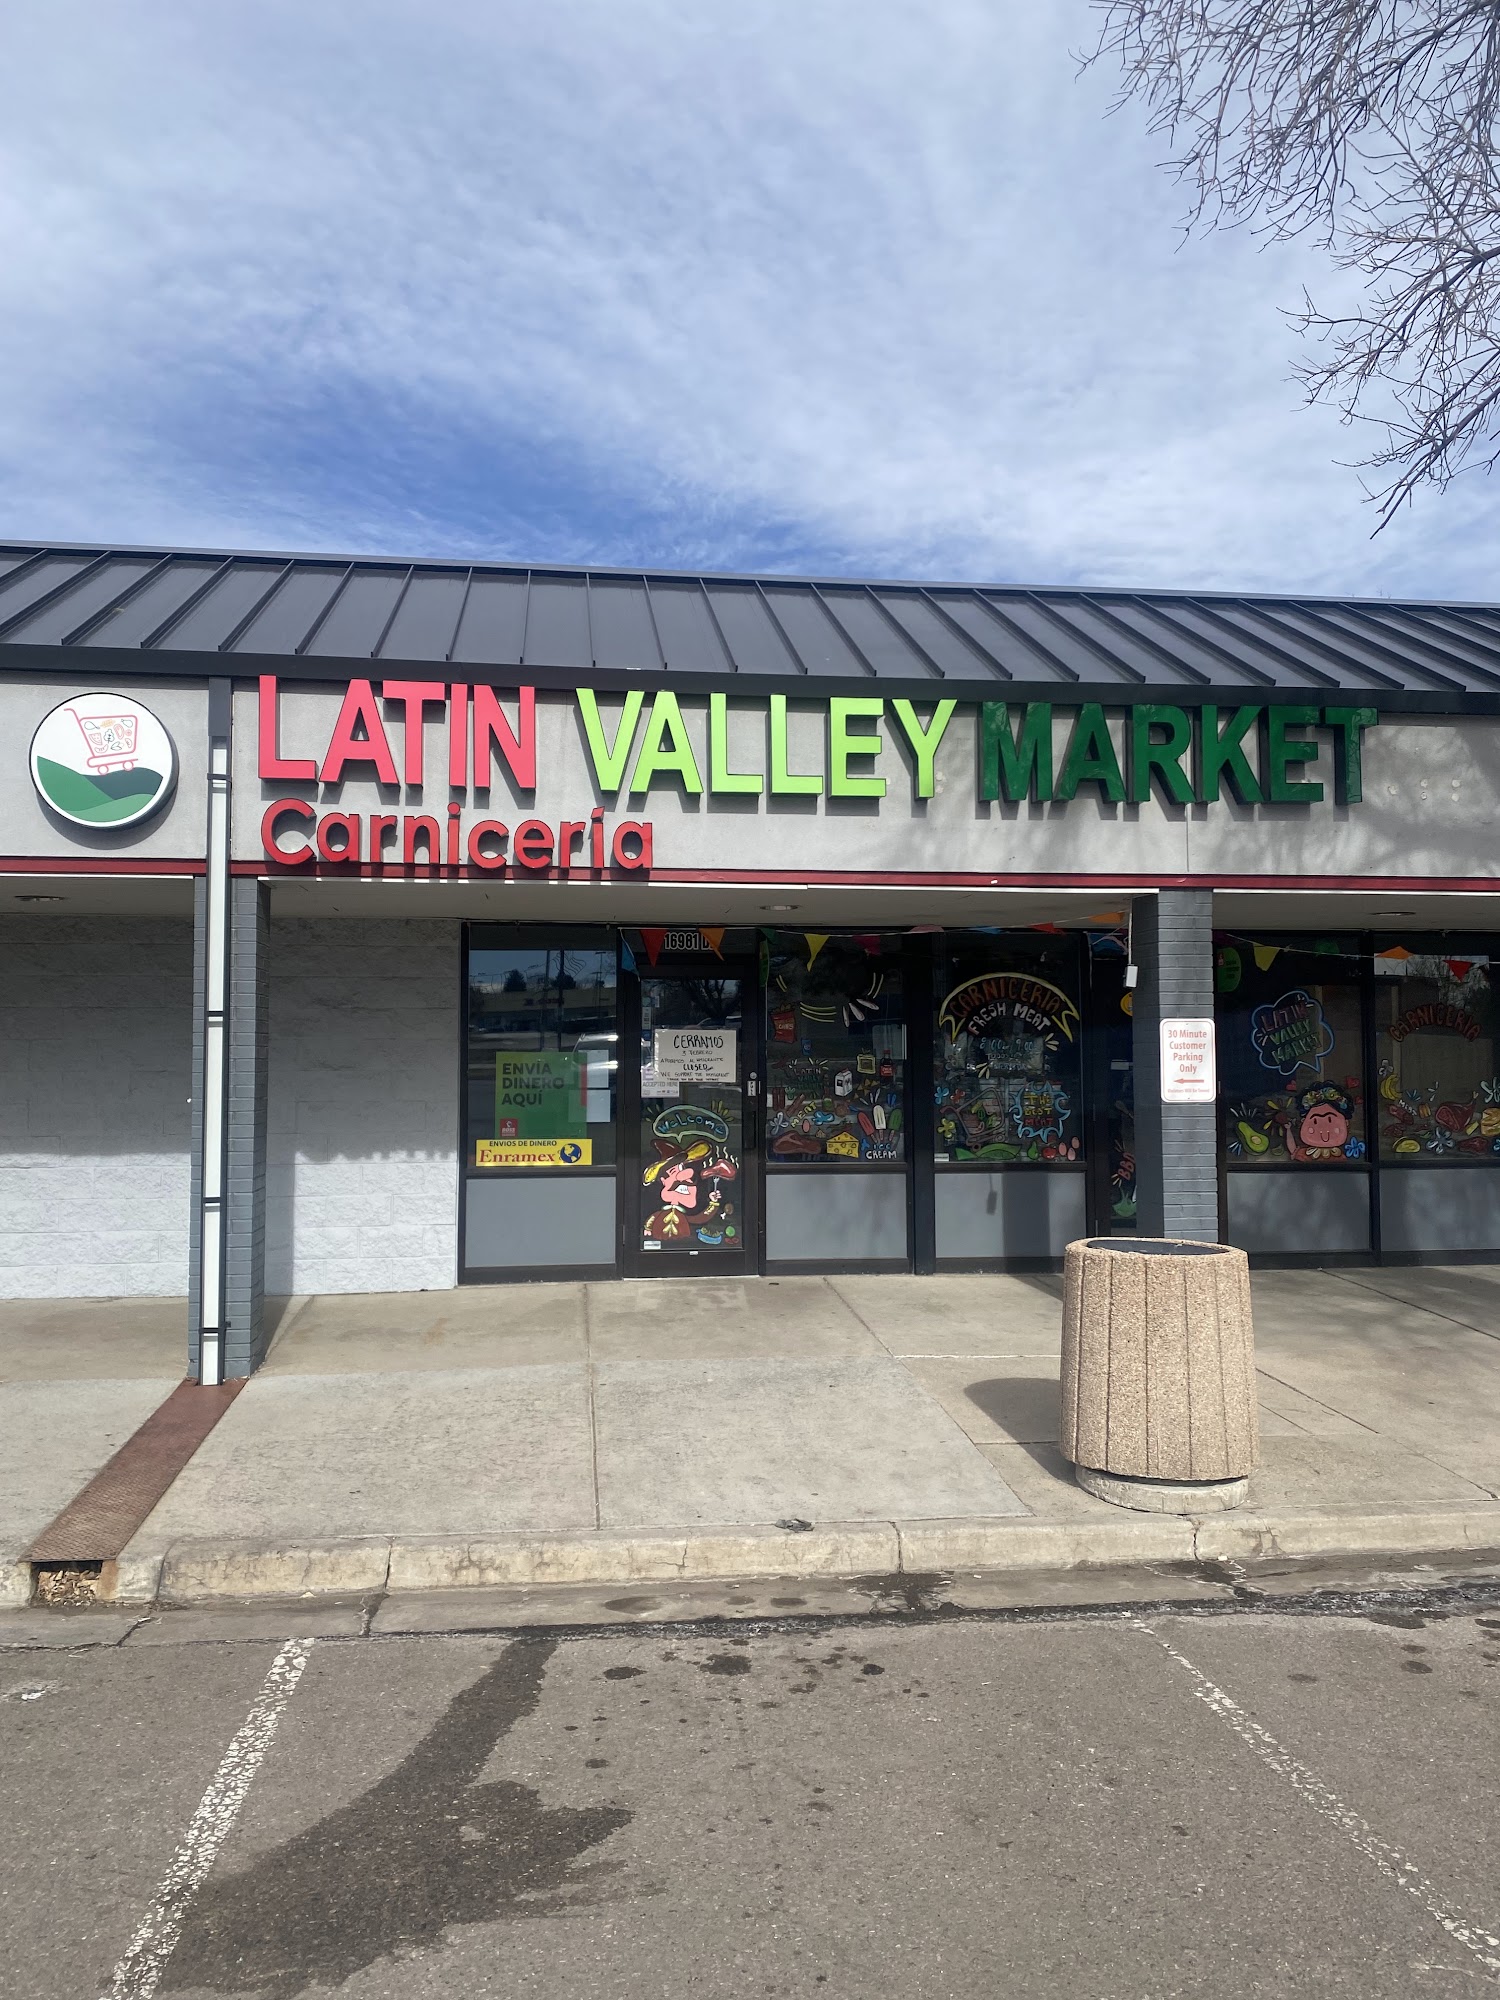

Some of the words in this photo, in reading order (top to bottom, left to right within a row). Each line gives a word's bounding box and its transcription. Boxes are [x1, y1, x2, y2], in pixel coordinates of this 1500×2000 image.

[258, 675, 537, 790] LATIN
[575, 687, 957, 797] VALLEY
[978, 701, 1378, 803] MARKET
[260, 797, 653, 869] Carnicería
[664, 932, 699, 950] 16981
[948, 976, 1062, 1018] CARNICERIA
[967, 1002, 1006, 1036] FRESH
[1013, 1003, 1052, 1032] MEAT
[1260, 1002, 1309, 1032] LATIN
[1388, 1002, 1481, 1042] CARNICERIA
[1168, 1029, 1178, 1038] 30
[1179, 1029, 1207, 1038] Minute
[1269, 1019, 1311, 1045] VALLEY
[673, 1034, 724, 1049] CERRAMOS
[1169, 1041, 1207, 1050] Customer
[1271, 1032, 1323, 1064] MARKET
[1173, 1052, 1203, 1063] Parking
[502, 1061, 552, 1075] ENVÍA
[683, 1063, 708, 1071] CLOSED
[1179, 1063, 1198, 1075] Only
[502, 1077, 565, 1089] DINERO
[501, 1090, 543, 1108] AQUÍ
[791, 1100, 817, 1128] MEAT
[479, 1149, 556, 1163] Enramex
[865, 1150, 898, 1160] CREAM
